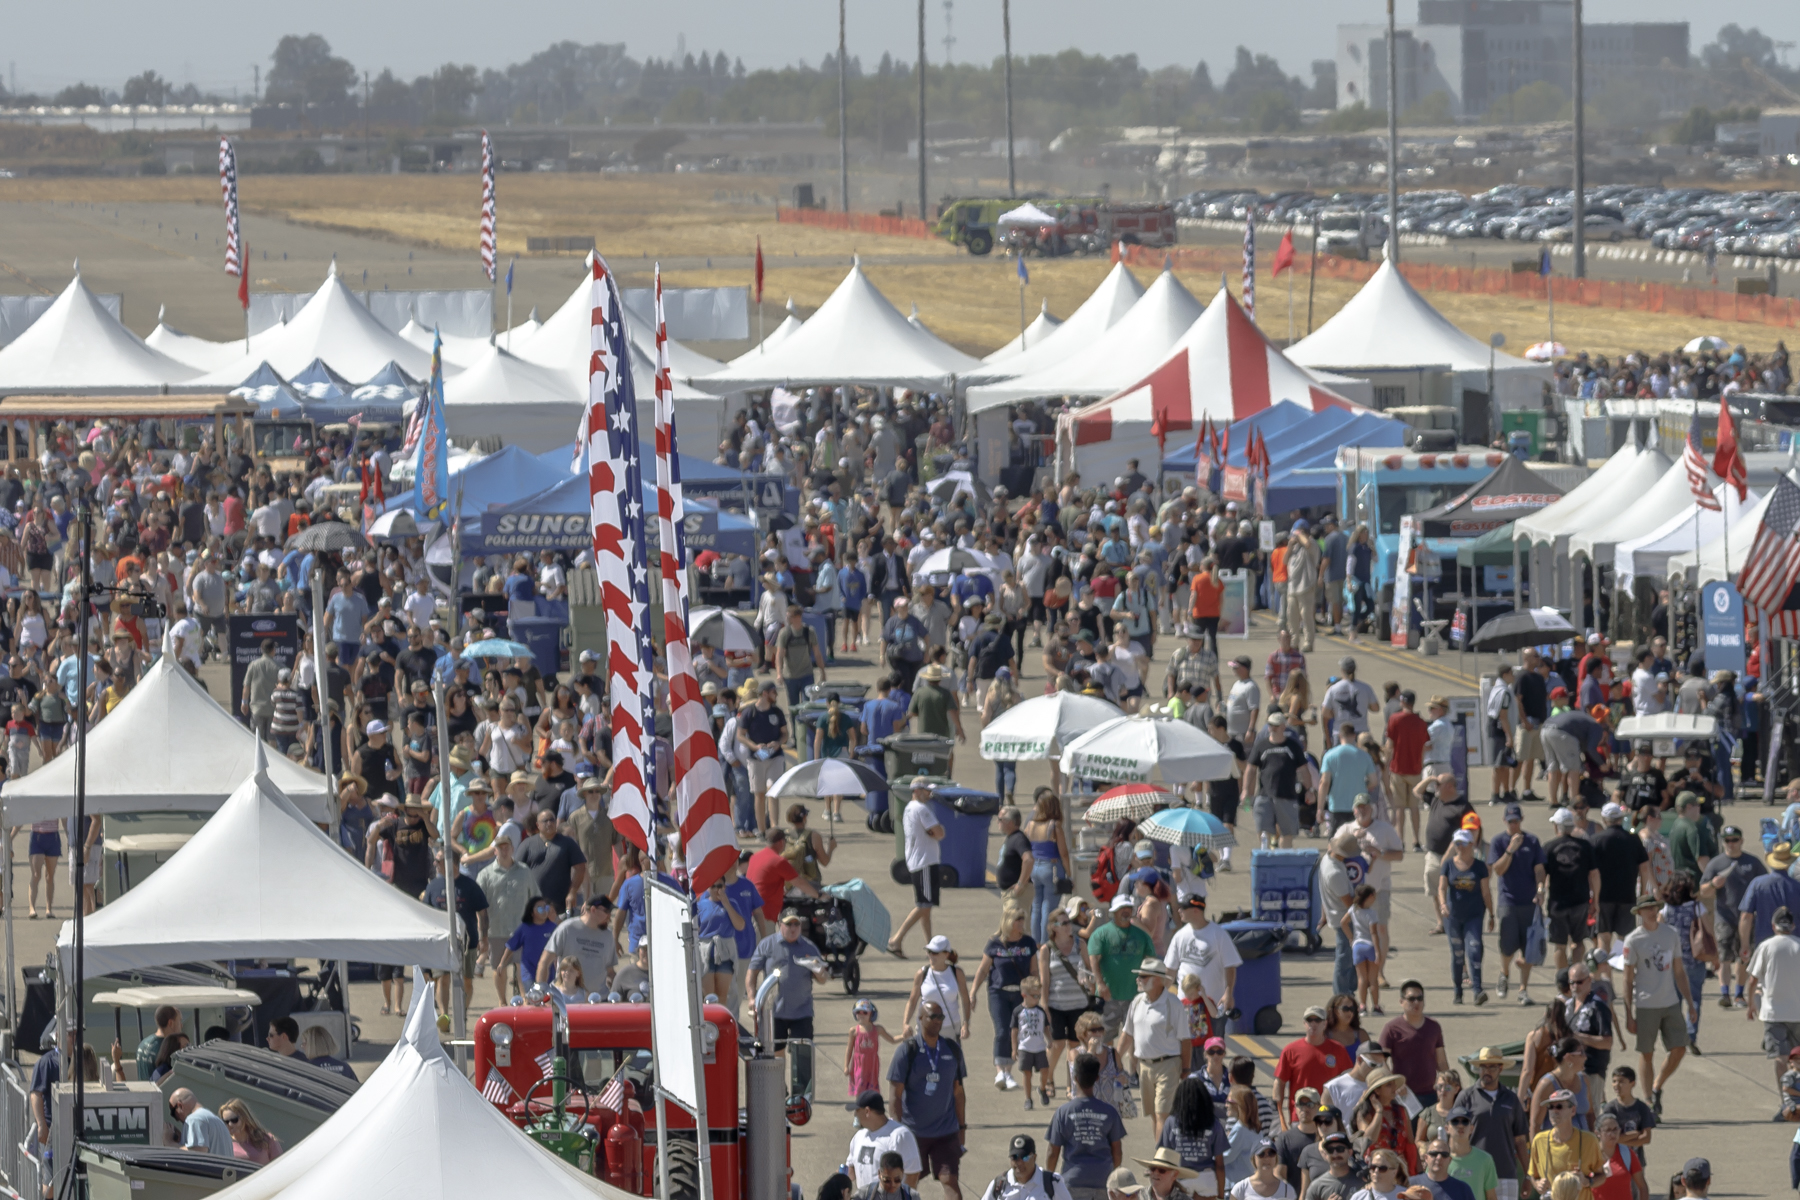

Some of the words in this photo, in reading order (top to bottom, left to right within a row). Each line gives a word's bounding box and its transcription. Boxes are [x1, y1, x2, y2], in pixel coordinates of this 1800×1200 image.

[985, 741, 1046, 753] PRETZELS
[1087, 753, 1138, 768] FROZEN
[1074, 765, 1148, 783] LEMONADE
[83, 1107, 147, 1131] ATM
